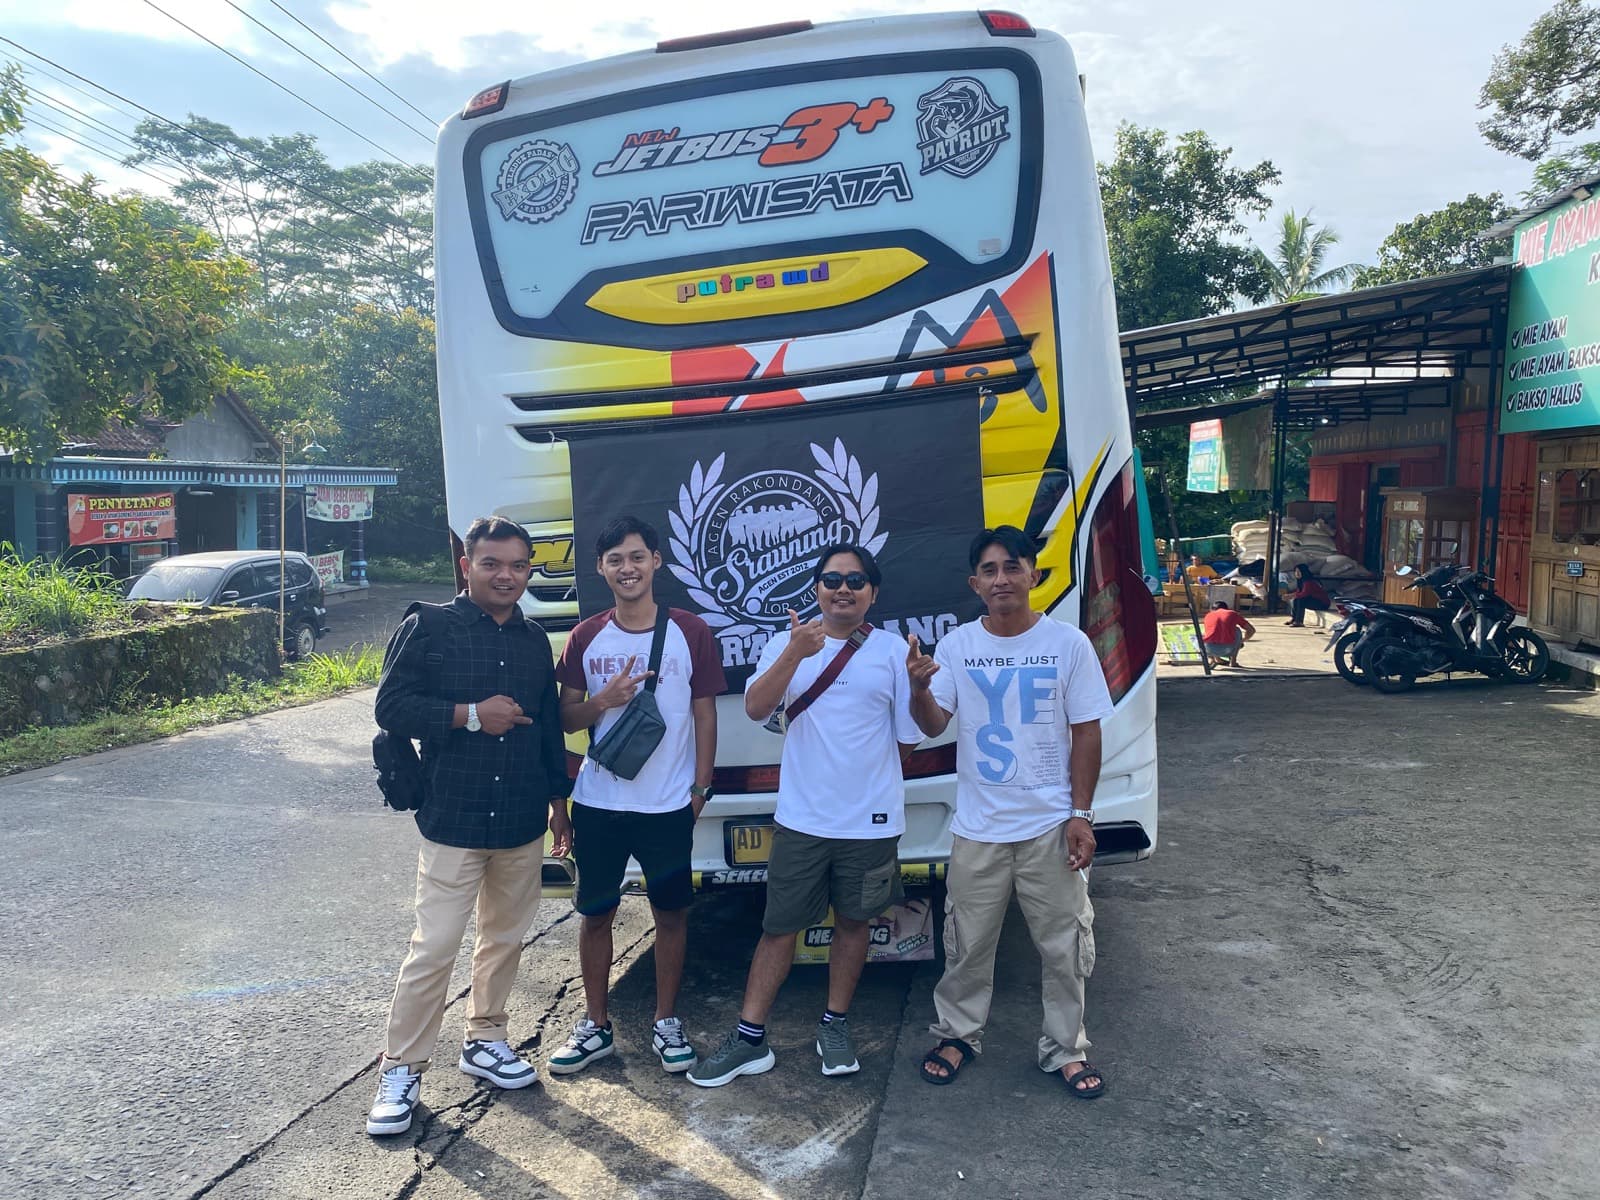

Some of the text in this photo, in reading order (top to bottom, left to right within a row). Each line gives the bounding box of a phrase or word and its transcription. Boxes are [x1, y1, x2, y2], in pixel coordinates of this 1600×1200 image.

[593, 125, 780, 177] JETBUS
[624, 127, 680, 148] NEW
[922, 115, 1006, 168] PATRIOT
[492, 145, 580, 219] EXOTIC
[581, 162, 913, 245] PARIWISATA
[1518, 220, 1548, 268] MIE
[676, 273, 775, 303] putra
[1521, 315, 1568, 347] MIE AYAM
[1518, 357, 1536, 380] MIE
[1536, 351, 1565, 377] AYAM
[1516, 381, 1583, 412] BAKSO HALUS
[89, 497, 172, 510] PENYETAN 88
[708, 476, 833, 554] AGEN RAKONDANG
[790, 562, 809, 575] 2012
[764, 602, 790, 615] LOR
[588, 655, 680, 676] NEVAA
[964, 655, 1059, 668] MAYBE JUST
[737, 828, 762, 850] AD
